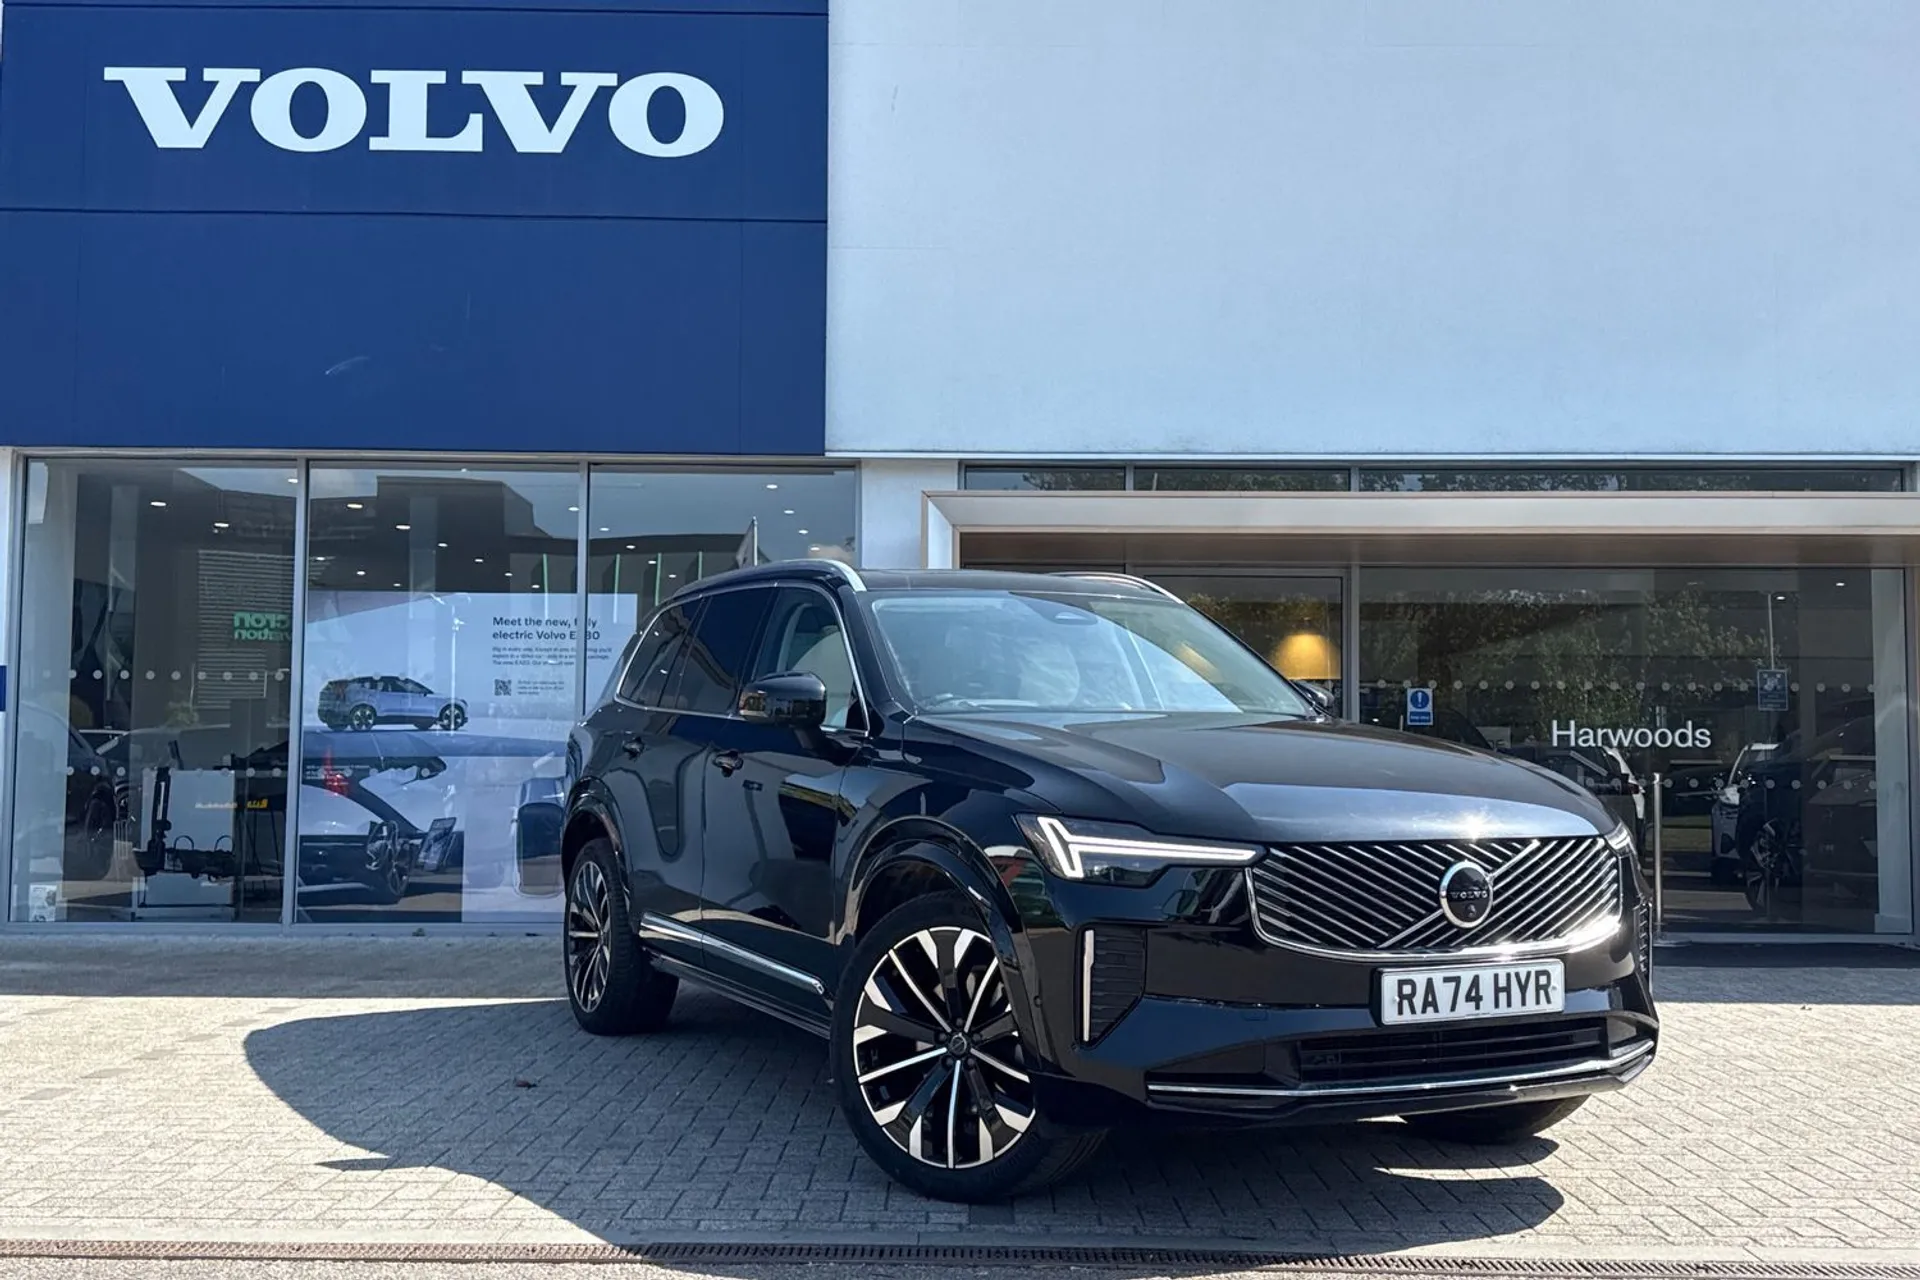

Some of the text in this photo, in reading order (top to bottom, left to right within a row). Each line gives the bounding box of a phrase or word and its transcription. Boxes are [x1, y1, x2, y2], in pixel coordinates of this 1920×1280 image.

[103, 66, 725, 158] VOLVO
[492, 617, 597, 628] Meet the new, fly
[492, 631, 533, 640] electric
[536, 631, 566, 640] Volvo
[1551, 719, 1711, 749] Harwoods
[1396, 969, 1553, 1016] RA74 HYR
